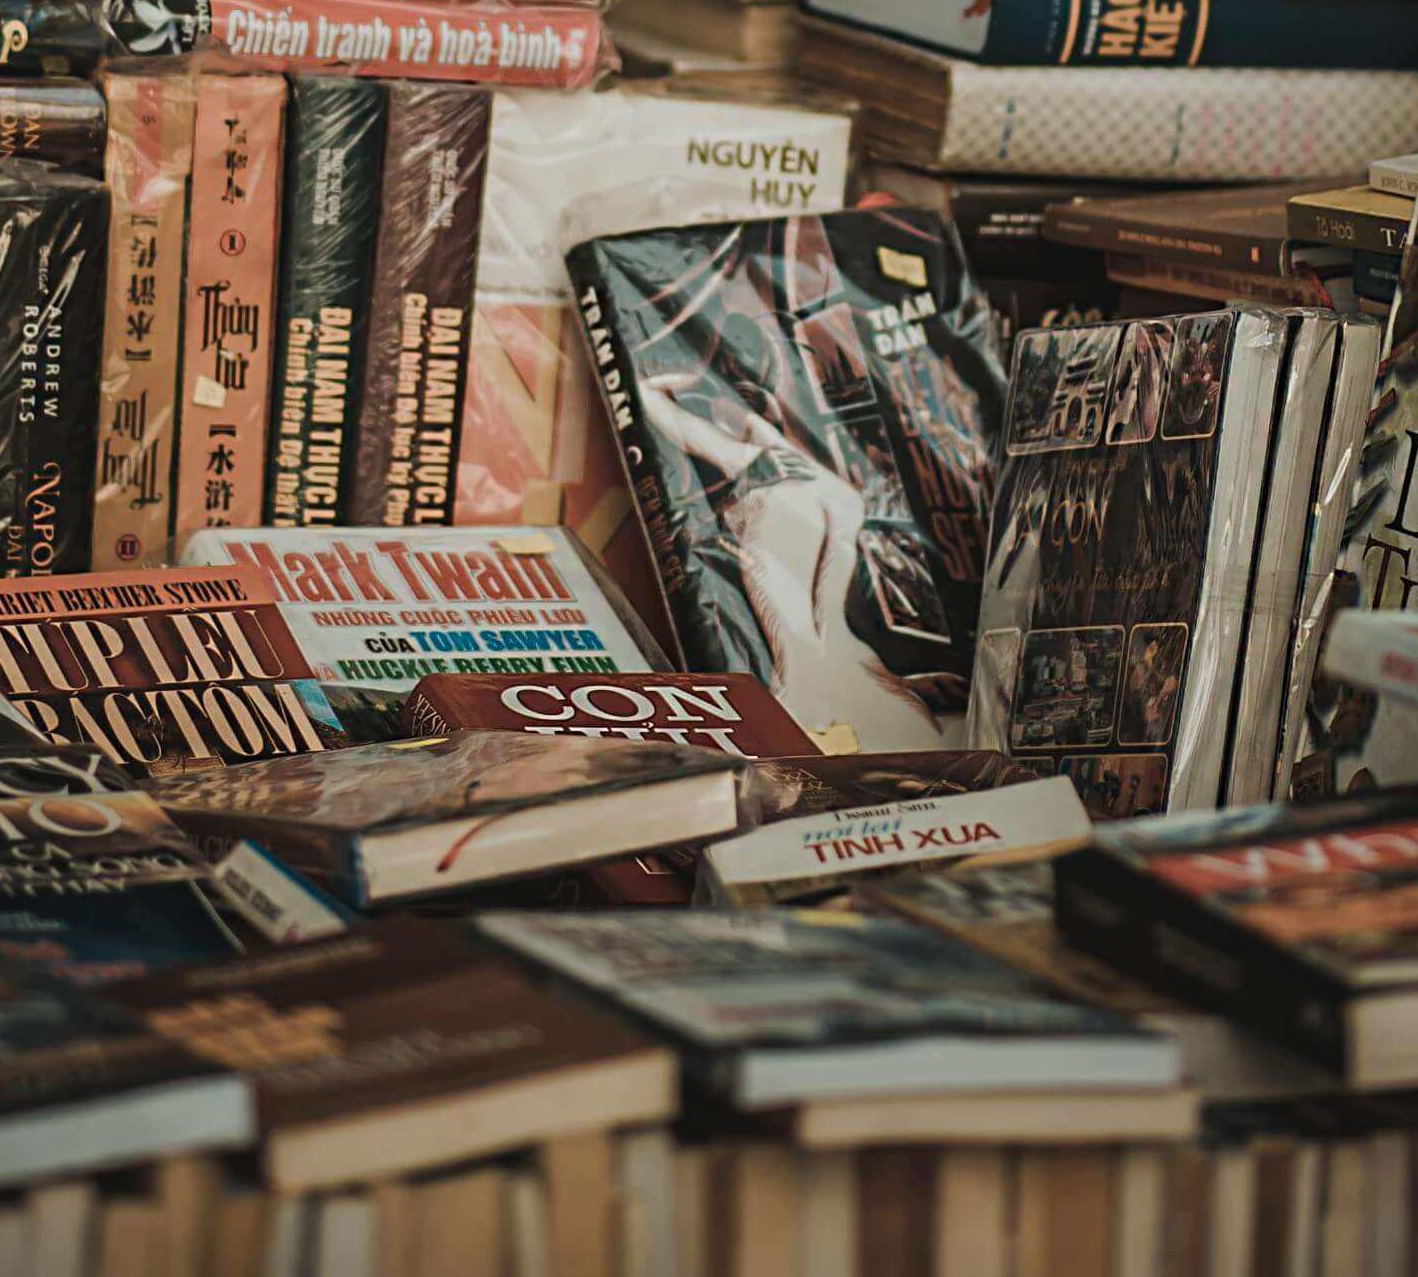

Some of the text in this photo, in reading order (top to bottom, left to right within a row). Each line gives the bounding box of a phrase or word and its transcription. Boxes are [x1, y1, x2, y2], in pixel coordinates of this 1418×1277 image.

[314, 12, 563, 69] tranh và bình
[749, 178, 818, 208] HUY
[19, 304, 40, 424] ROBERTS
[41, 304, 63, 419] ANDREW
[300, 306, 353, 505] ĐẠI NAM THỰC
[413, 306, 464, 505] ĐẠI NAM THỰC
[56, 583, 166, 613] BEECHER
[163, 578, 250, 606] STOWE
[227, 538, 578, 603] Mark Twain
[313, 607, 396, 627] NHỮNG
[364, 629, 607, 655] CỦA TOM SAWYER
[144, 680, 329, 763] TÔM
[500, 683, 744, 724] CON
